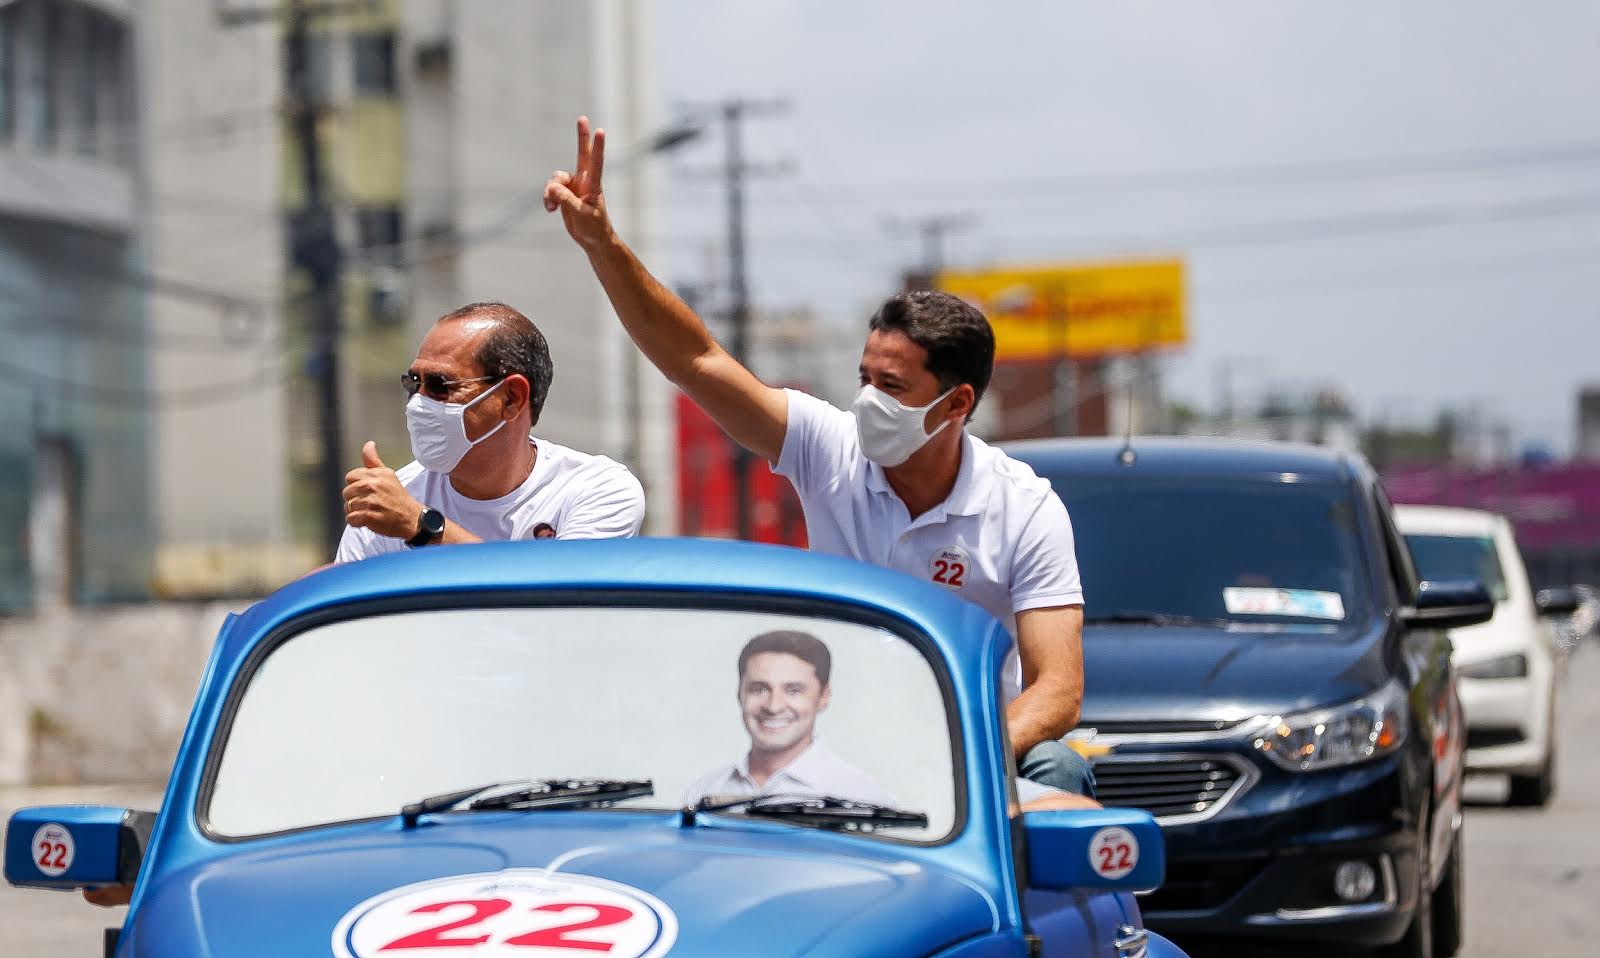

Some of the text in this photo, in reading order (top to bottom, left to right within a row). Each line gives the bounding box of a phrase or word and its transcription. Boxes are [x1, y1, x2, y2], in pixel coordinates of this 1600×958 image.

[933, 560, 965, 586] 22
[38, 841, 67, 869] 22
[1099, 844, 1132, 872] 22
[378, 898, 634, 952] 22
